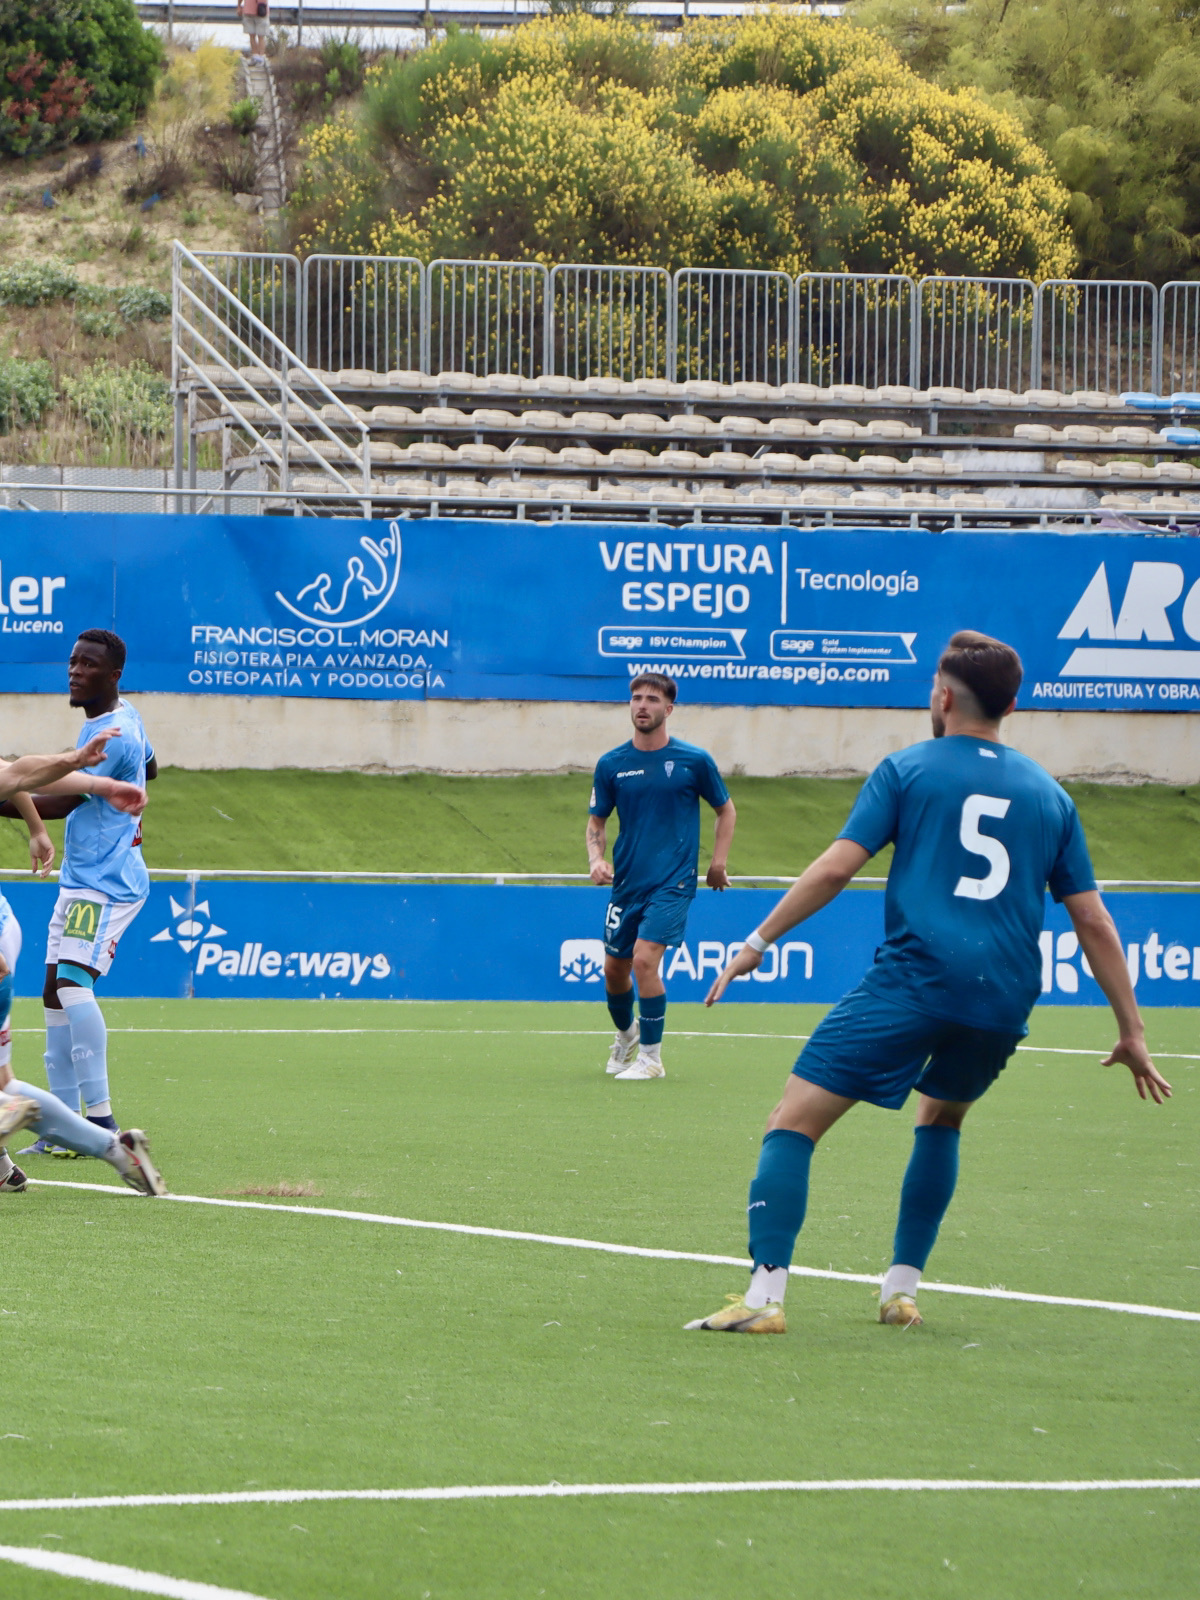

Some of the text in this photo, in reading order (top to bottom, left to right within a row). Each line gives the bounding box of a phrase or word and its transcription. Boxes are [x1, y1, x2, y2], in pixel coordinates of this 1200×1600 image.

[599, 541, 774, 575] VENTURA
[795, 568, 919, 596] Tecnología
[622, 581, 750, 618] ESPEJO
[3, 616, 63, 633] Lucena
[191, 626, 334, 646] FRANCISCO
[360, 630, 448, 648] MORAN
[609, 636, 727, 650] sage ISV Champion
[781, 639, 814, 653] sage
[194, 651, 433, 669] FISIOTERAPIA AVANZADA,
[188, 668, 446, 688] OSTEOPATÍA Y PODOLOGÍA
[628, 662, 890, 684] www.venturaespejo.com
[1032, 682, 1144, 698] ARQUITECTURA
[1145, 685, 1155, 698] Y
[953, 794, 1011, 900] 5
[606, 902, 623, 929] 15
